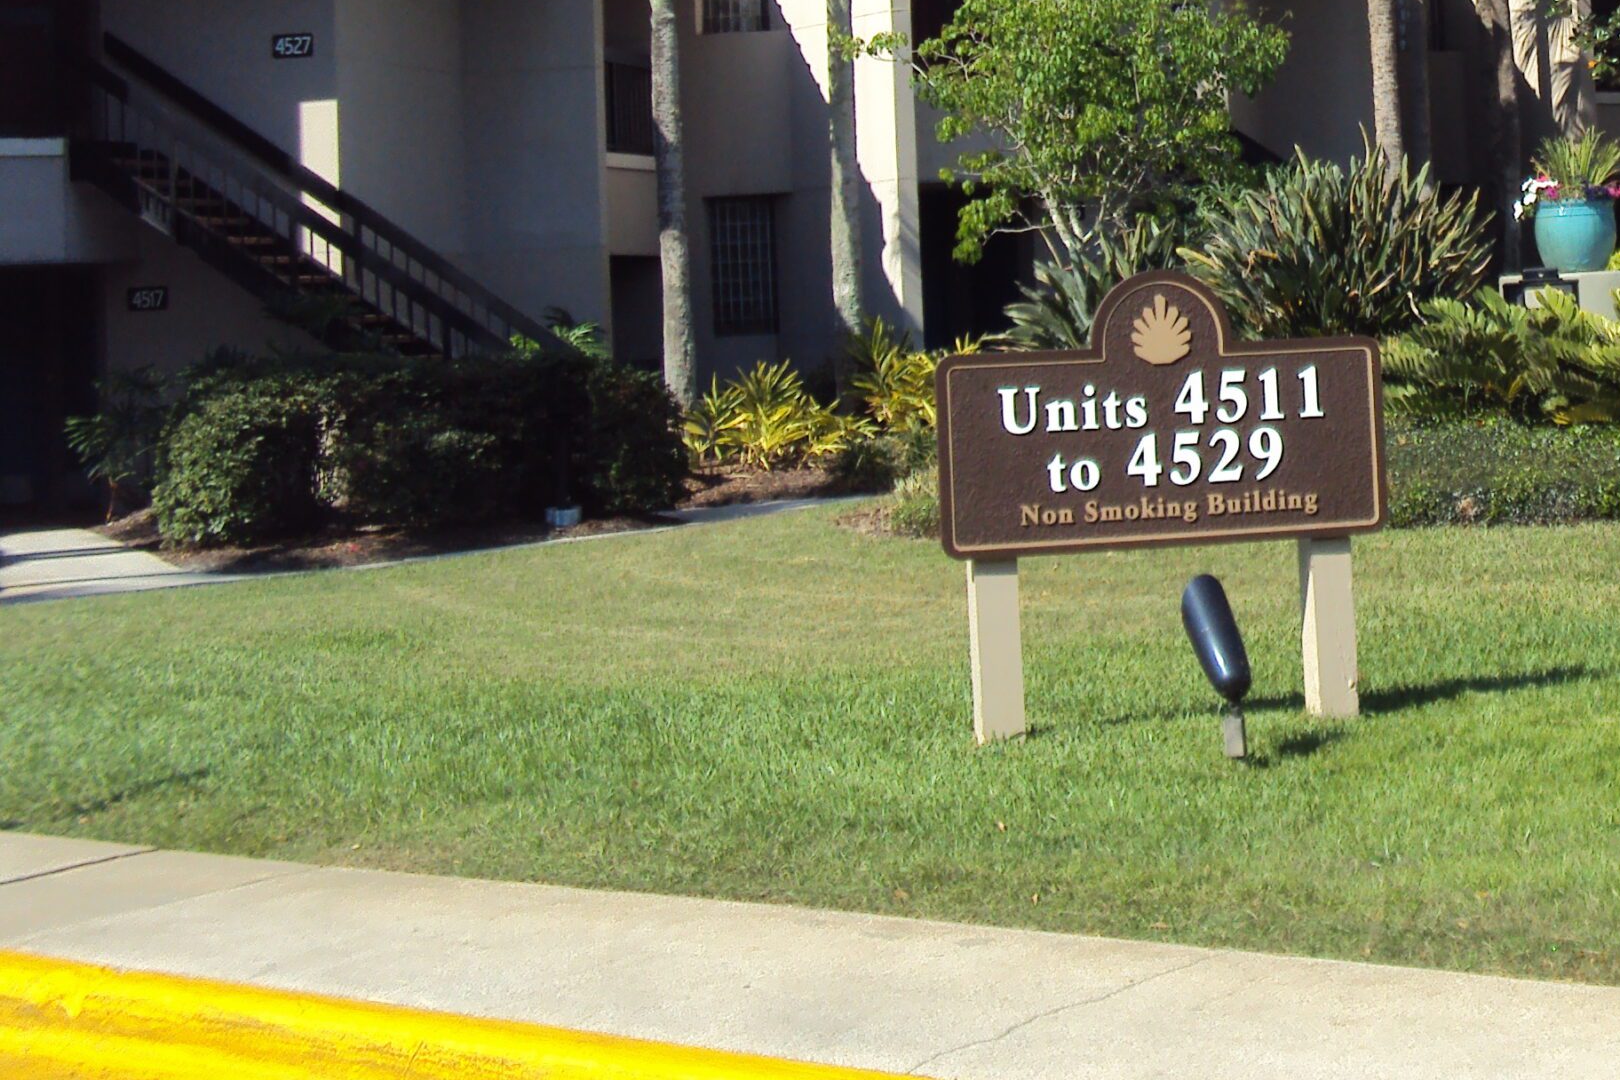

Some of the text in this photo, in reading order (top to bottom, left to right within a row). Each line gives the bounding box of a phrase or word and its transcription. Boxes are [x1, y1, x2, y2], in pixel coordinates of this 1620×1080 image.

[274, 36, 312, 55] 4527
[998, 366, 1325, 435] Units 4511
[1047, 427, 1284, 493] to 4529
[1021, 488, 1319, 526] Non Smoking Building
